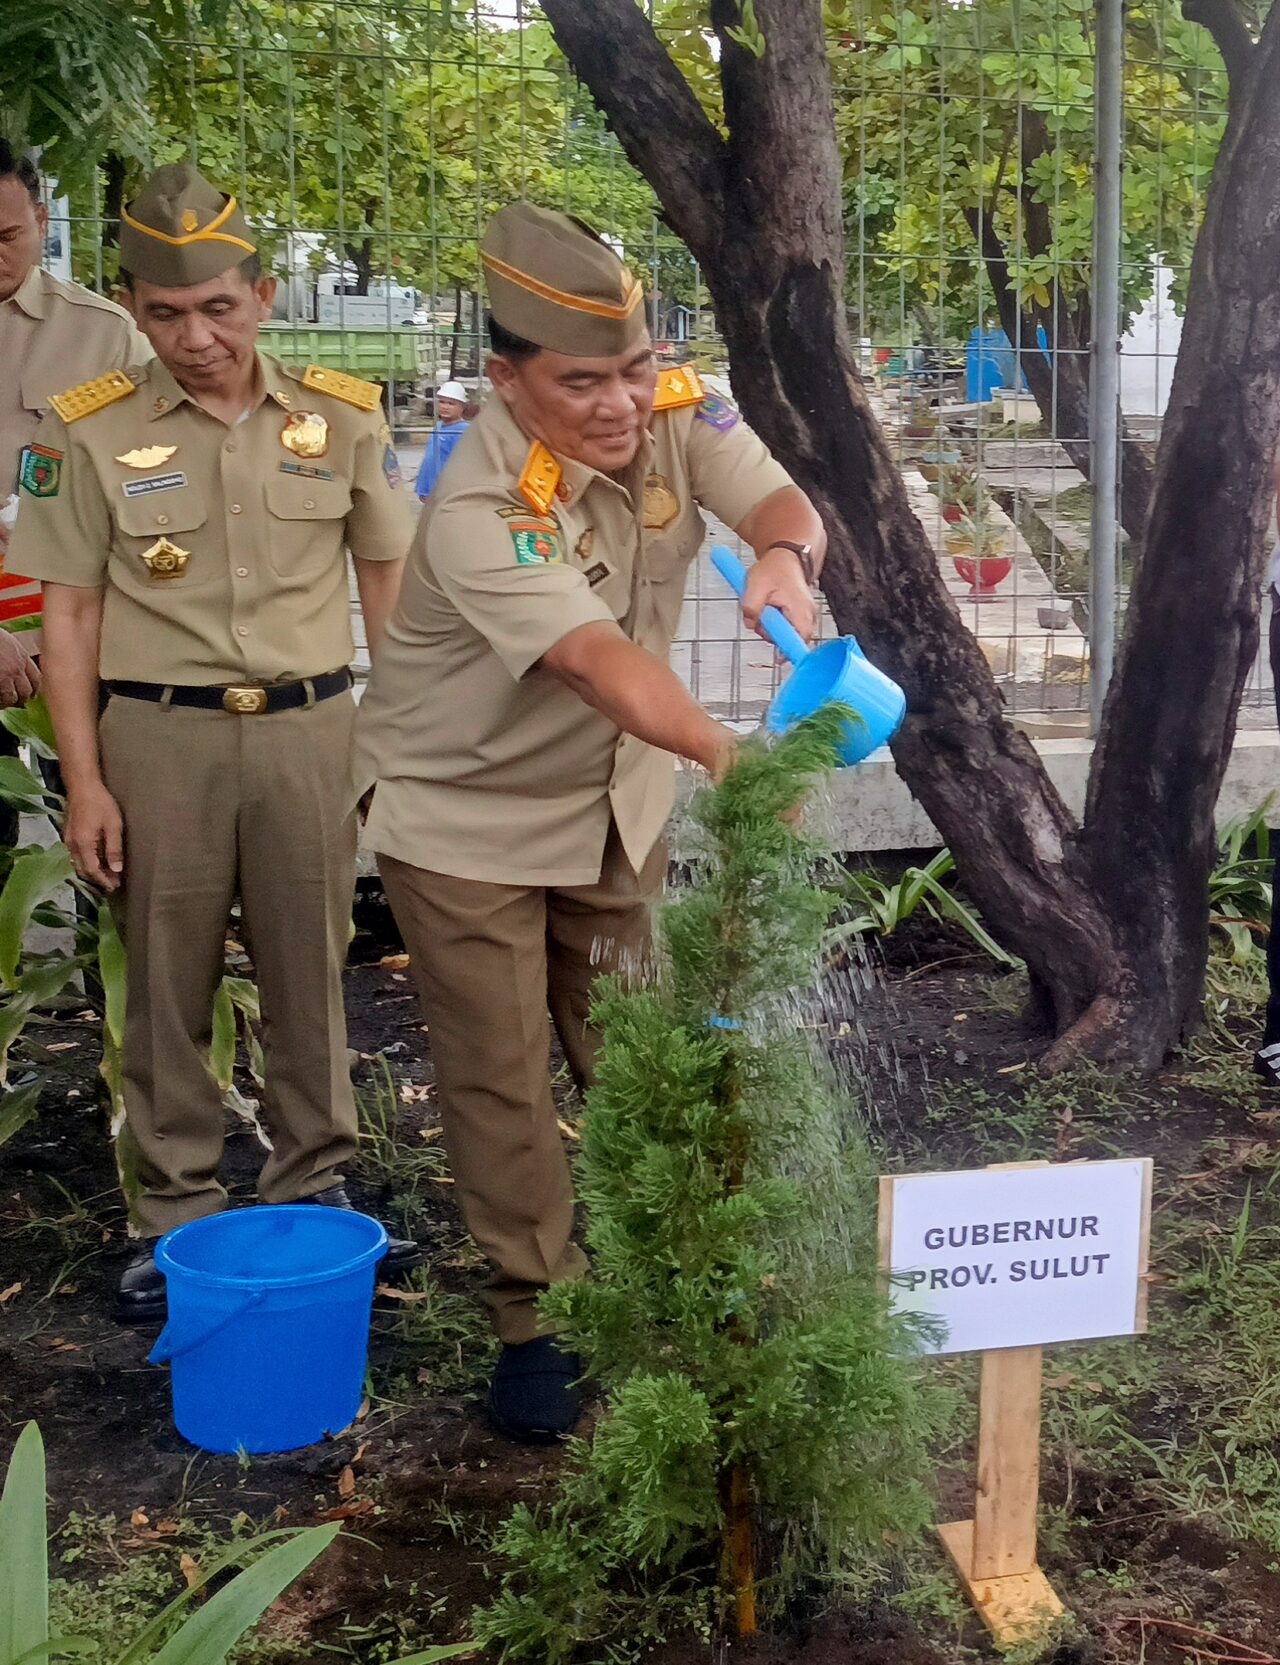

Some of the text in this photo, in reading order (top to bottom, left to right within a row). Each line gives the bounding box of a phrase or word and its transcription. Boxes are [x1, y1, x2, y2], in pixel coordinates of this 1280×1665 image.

[924, 1215, 1100, 1250] GUBERNUR
[909, 1253, 1111, 1292] PROV. SULUT
